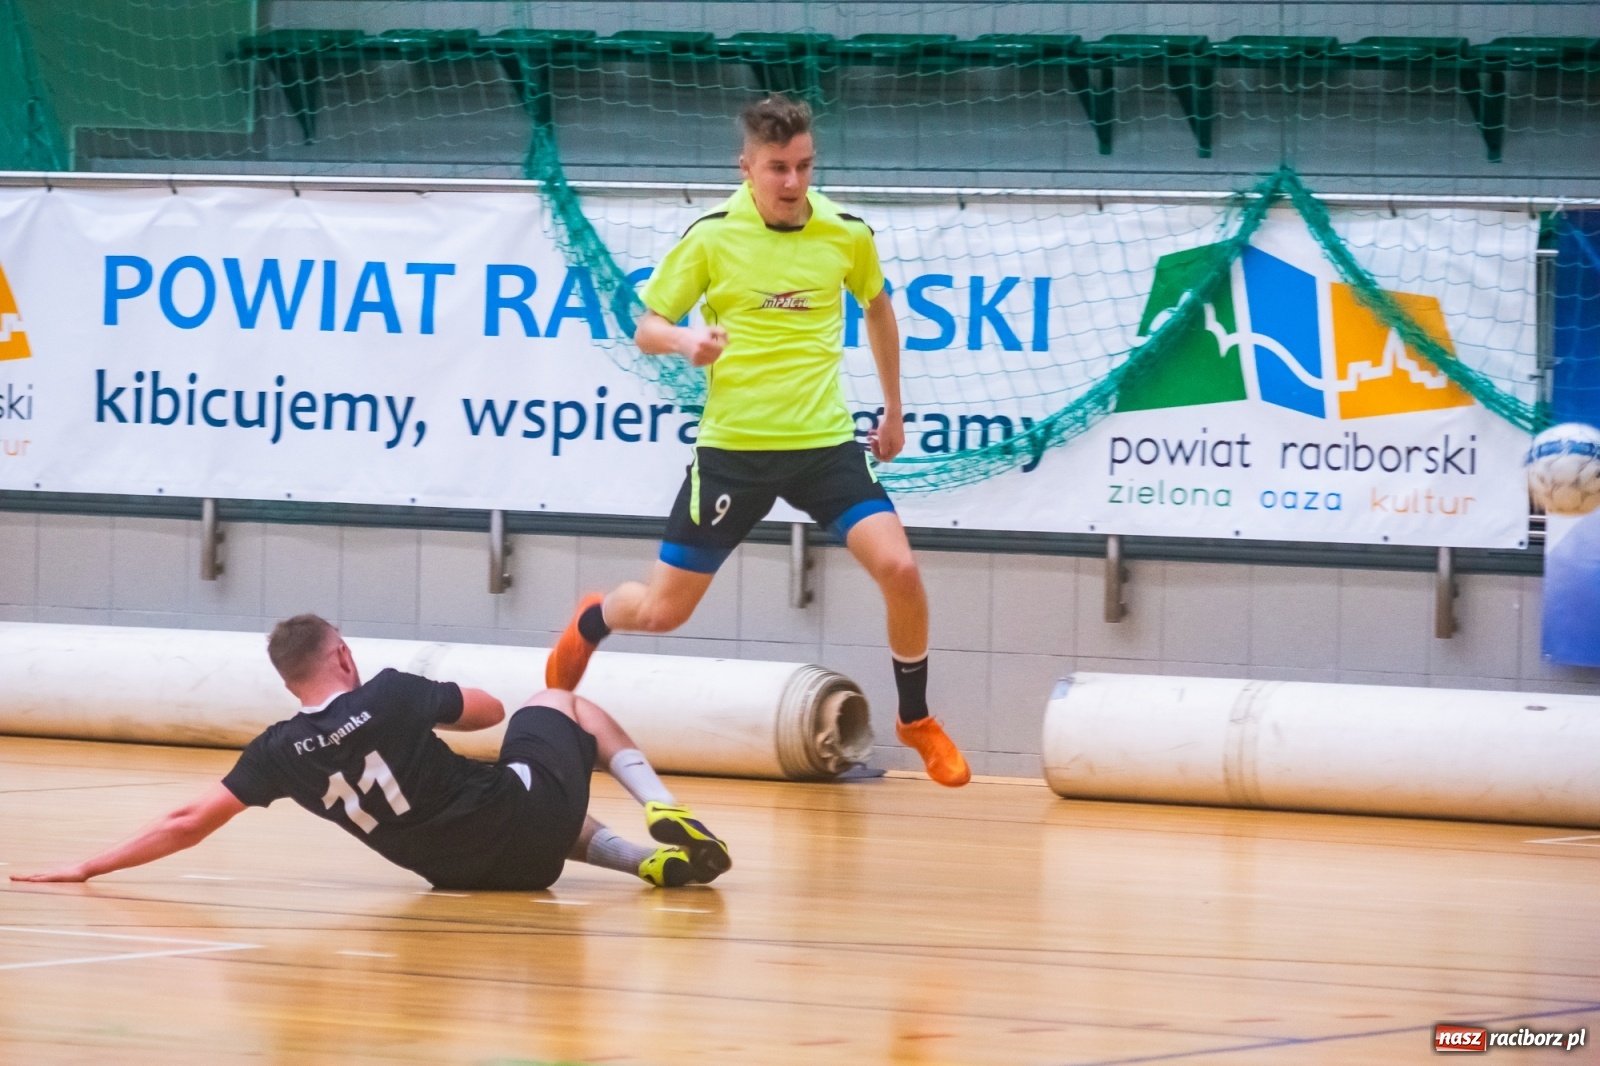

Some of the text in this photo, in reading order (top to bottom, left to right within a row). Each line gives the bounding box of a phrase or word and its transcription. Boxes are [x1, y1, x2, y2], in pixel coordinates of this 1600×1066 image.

[103, 255, 456, 335] POWIAT
[96, 369, 427, 449] kibicujemy,
[1109, 427, 1477, 476] powiat raciborski
[711, 493, 732, 527] 9
[1108, 478, 1476, 515] zielona oaza kultur
[293, 738, 316, 755] FC
[321, 750, 411, 834] 11
